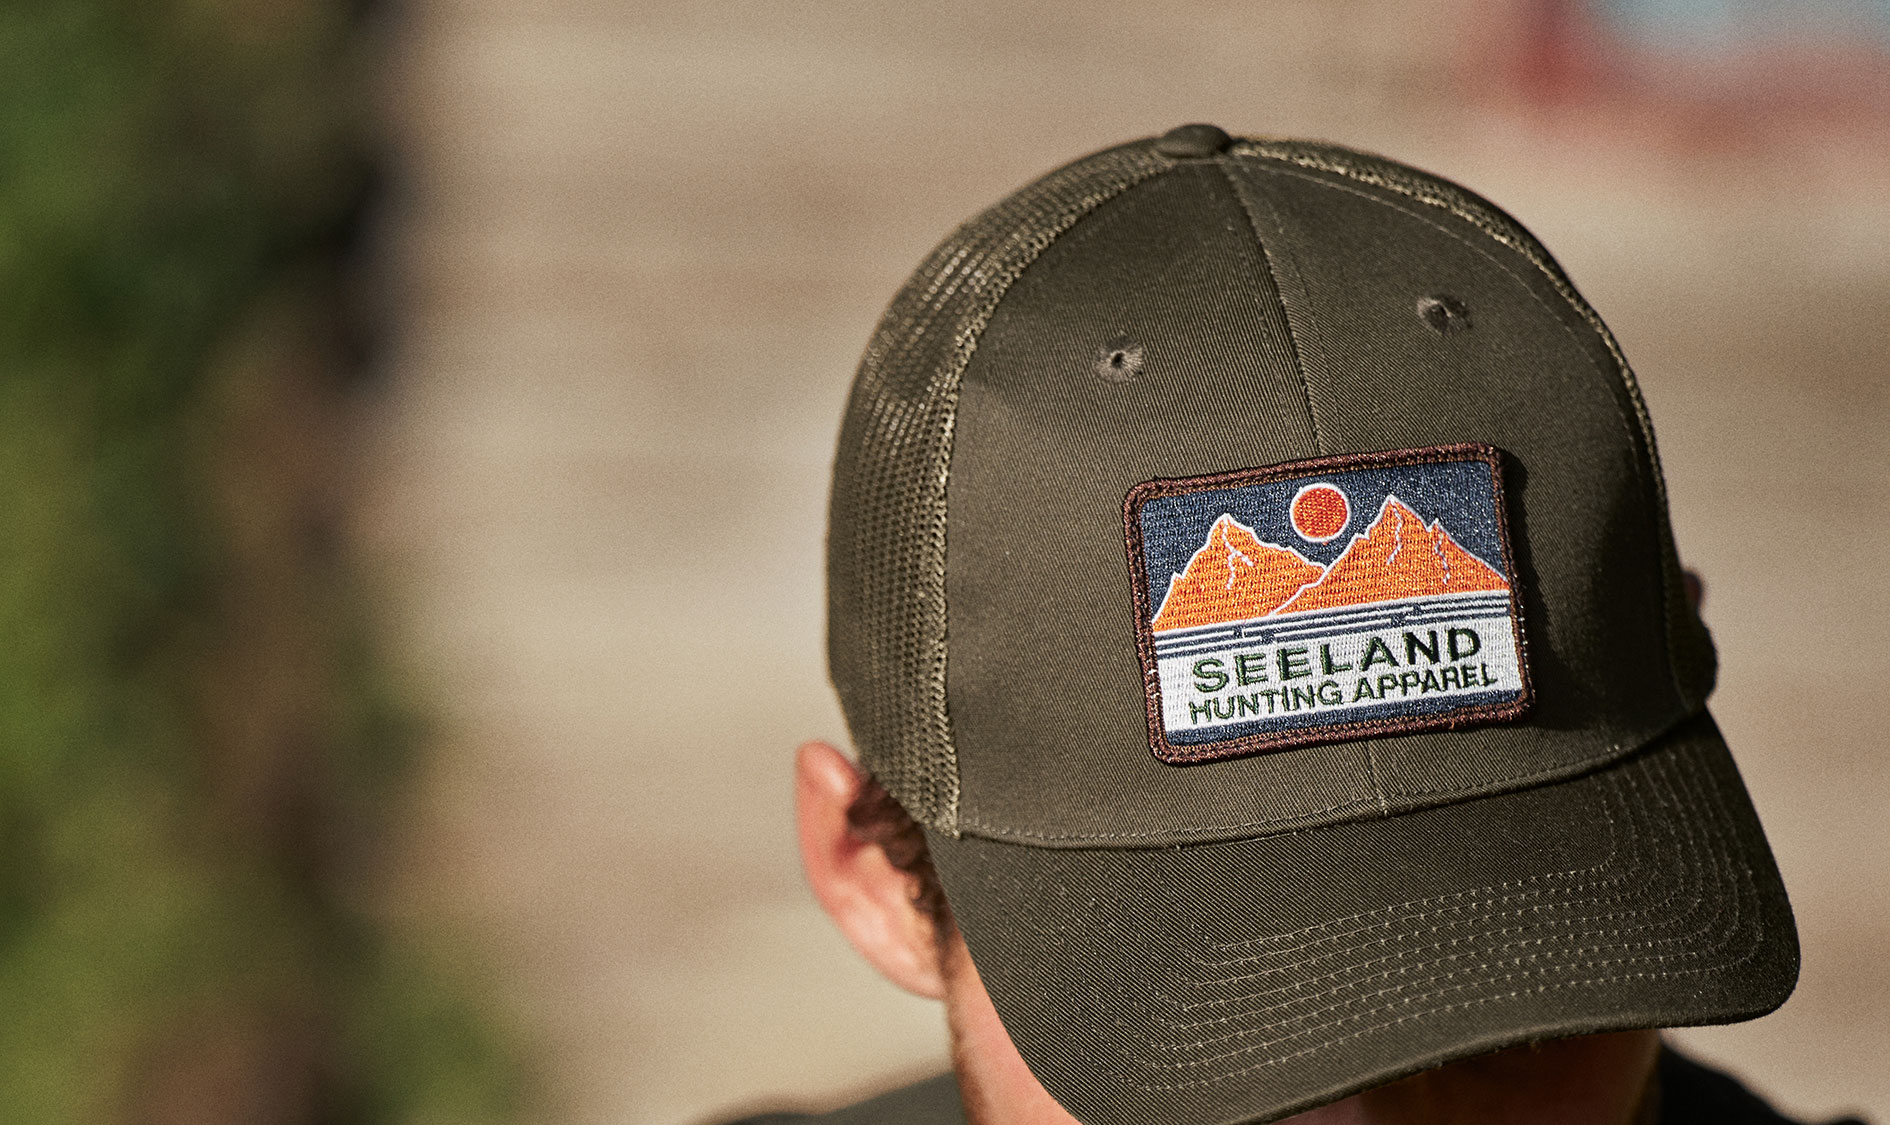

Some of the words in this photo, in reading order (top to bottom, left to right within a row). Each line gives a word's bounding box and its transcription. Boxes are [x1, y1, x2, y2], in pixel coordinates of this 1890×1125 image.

[1192, 627, 1481, 693] SEELAND
[1189, 680, 1342, 725] HUNTING
[1353, 663, 1498, 704] APPAREL
